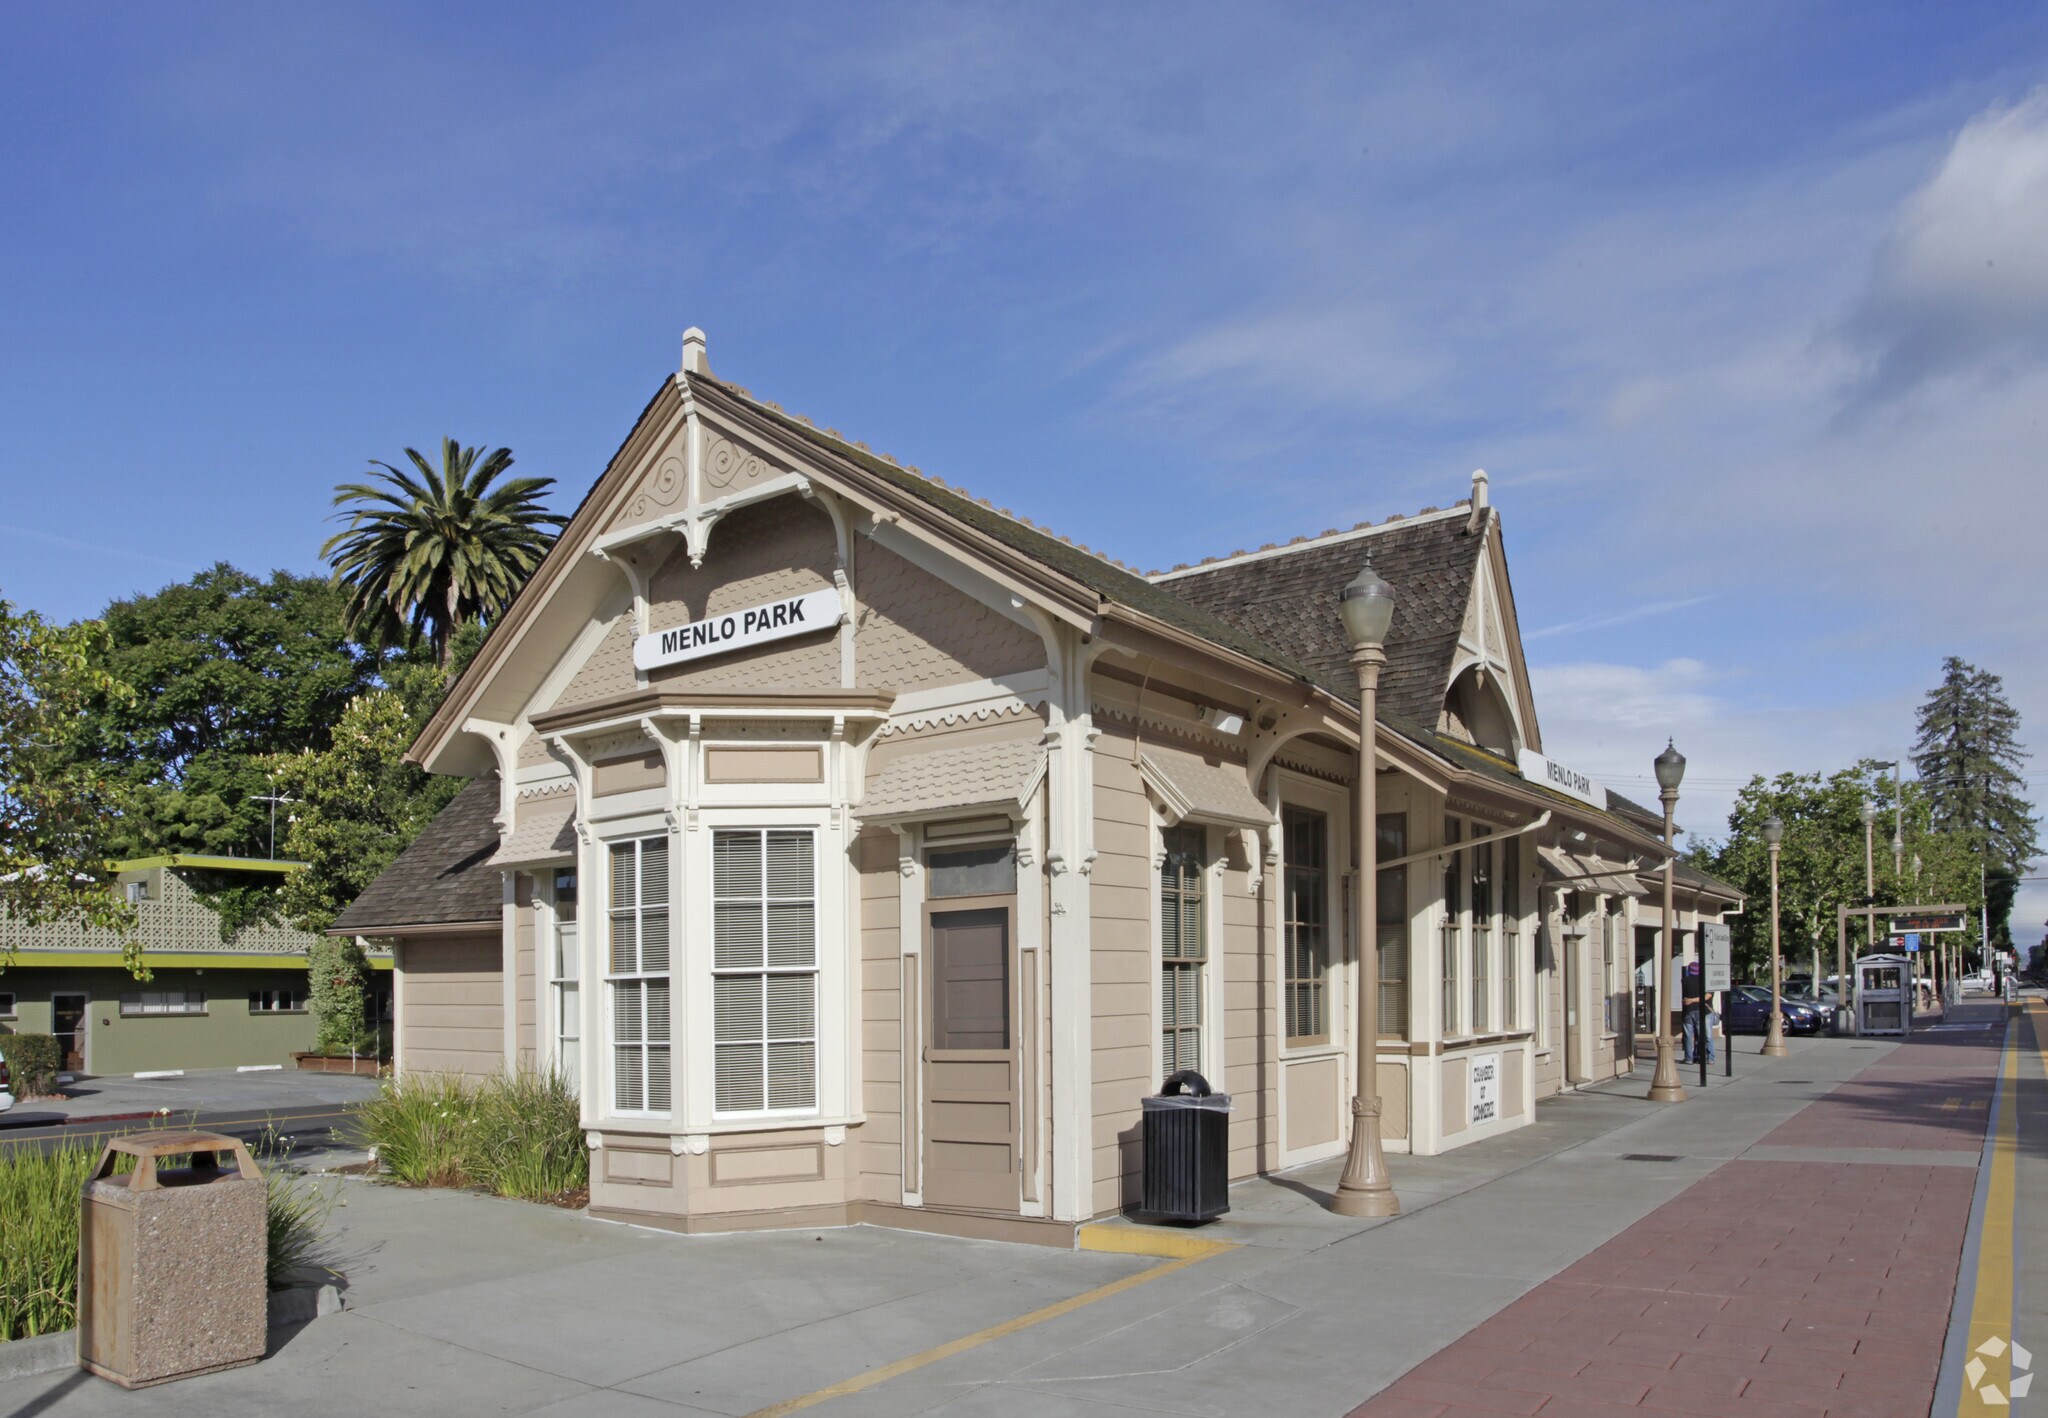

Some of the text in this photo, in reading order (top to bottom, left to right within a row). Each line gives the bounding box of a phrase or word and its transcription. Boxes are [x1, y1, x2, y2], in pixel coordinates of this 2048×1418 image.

[662, 599, 805, 654] MENLO PARK
[1546, 761, 1591, 796] MENLO PARK
